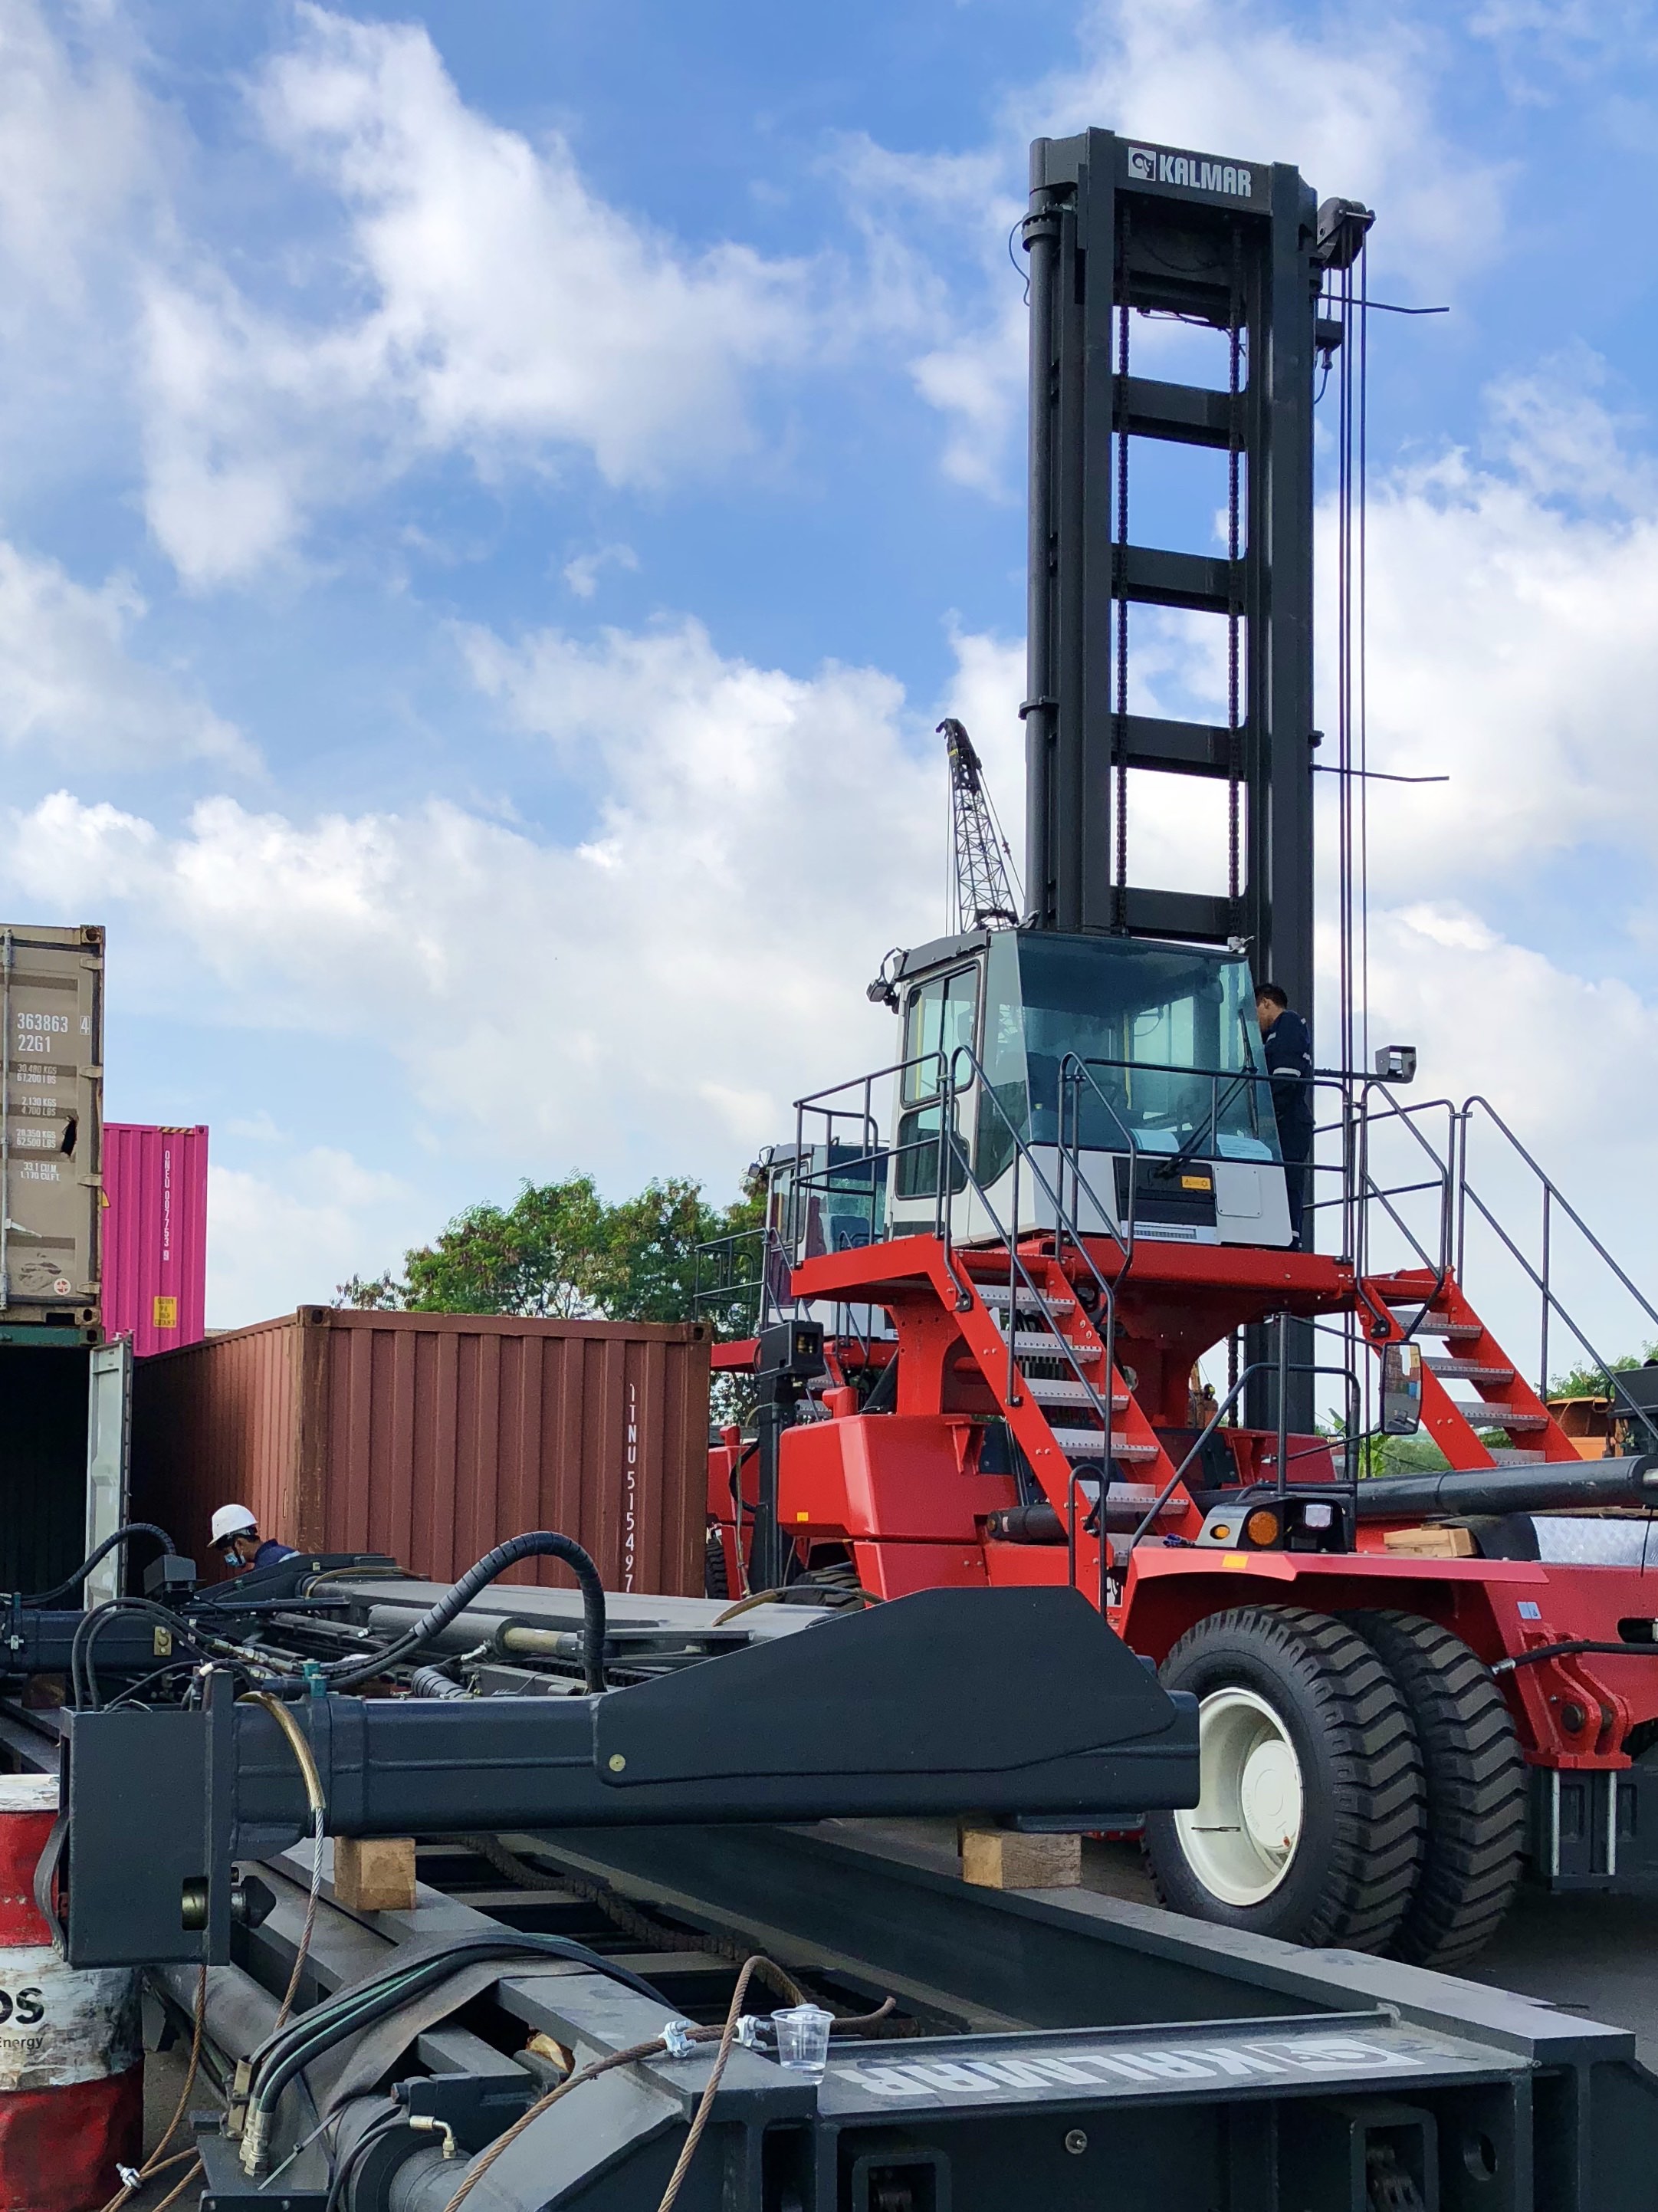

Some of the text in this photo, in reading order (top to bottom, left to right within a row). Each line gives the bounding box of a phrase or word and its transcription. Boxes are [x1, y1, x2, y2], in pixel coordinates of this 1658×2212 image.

[1160, 154, 1252, 198] KALMAR
[17, 1012, 90, 1034] 363863 4
[18, 1034, 51, 1053] 22G1
[18, 1063, 57, 1075] 30.480 KGS
[17, 1073, 41, 1083] 67.200
[21, 1096, 57, 1107] 2.130 KGS
[42, 1107, 57, 1116] LBS
[42, 1130, 56, 1139] KGS
[17, 1137, 56, 1149] 62.500 LBS
[23, 1162, 38, 1172] 33.1
[625, 1471, 635, 1592] 515497
[0, 2036, 44, 2049] nergy
[832, 2048, 1289, 2095] KALMAR
